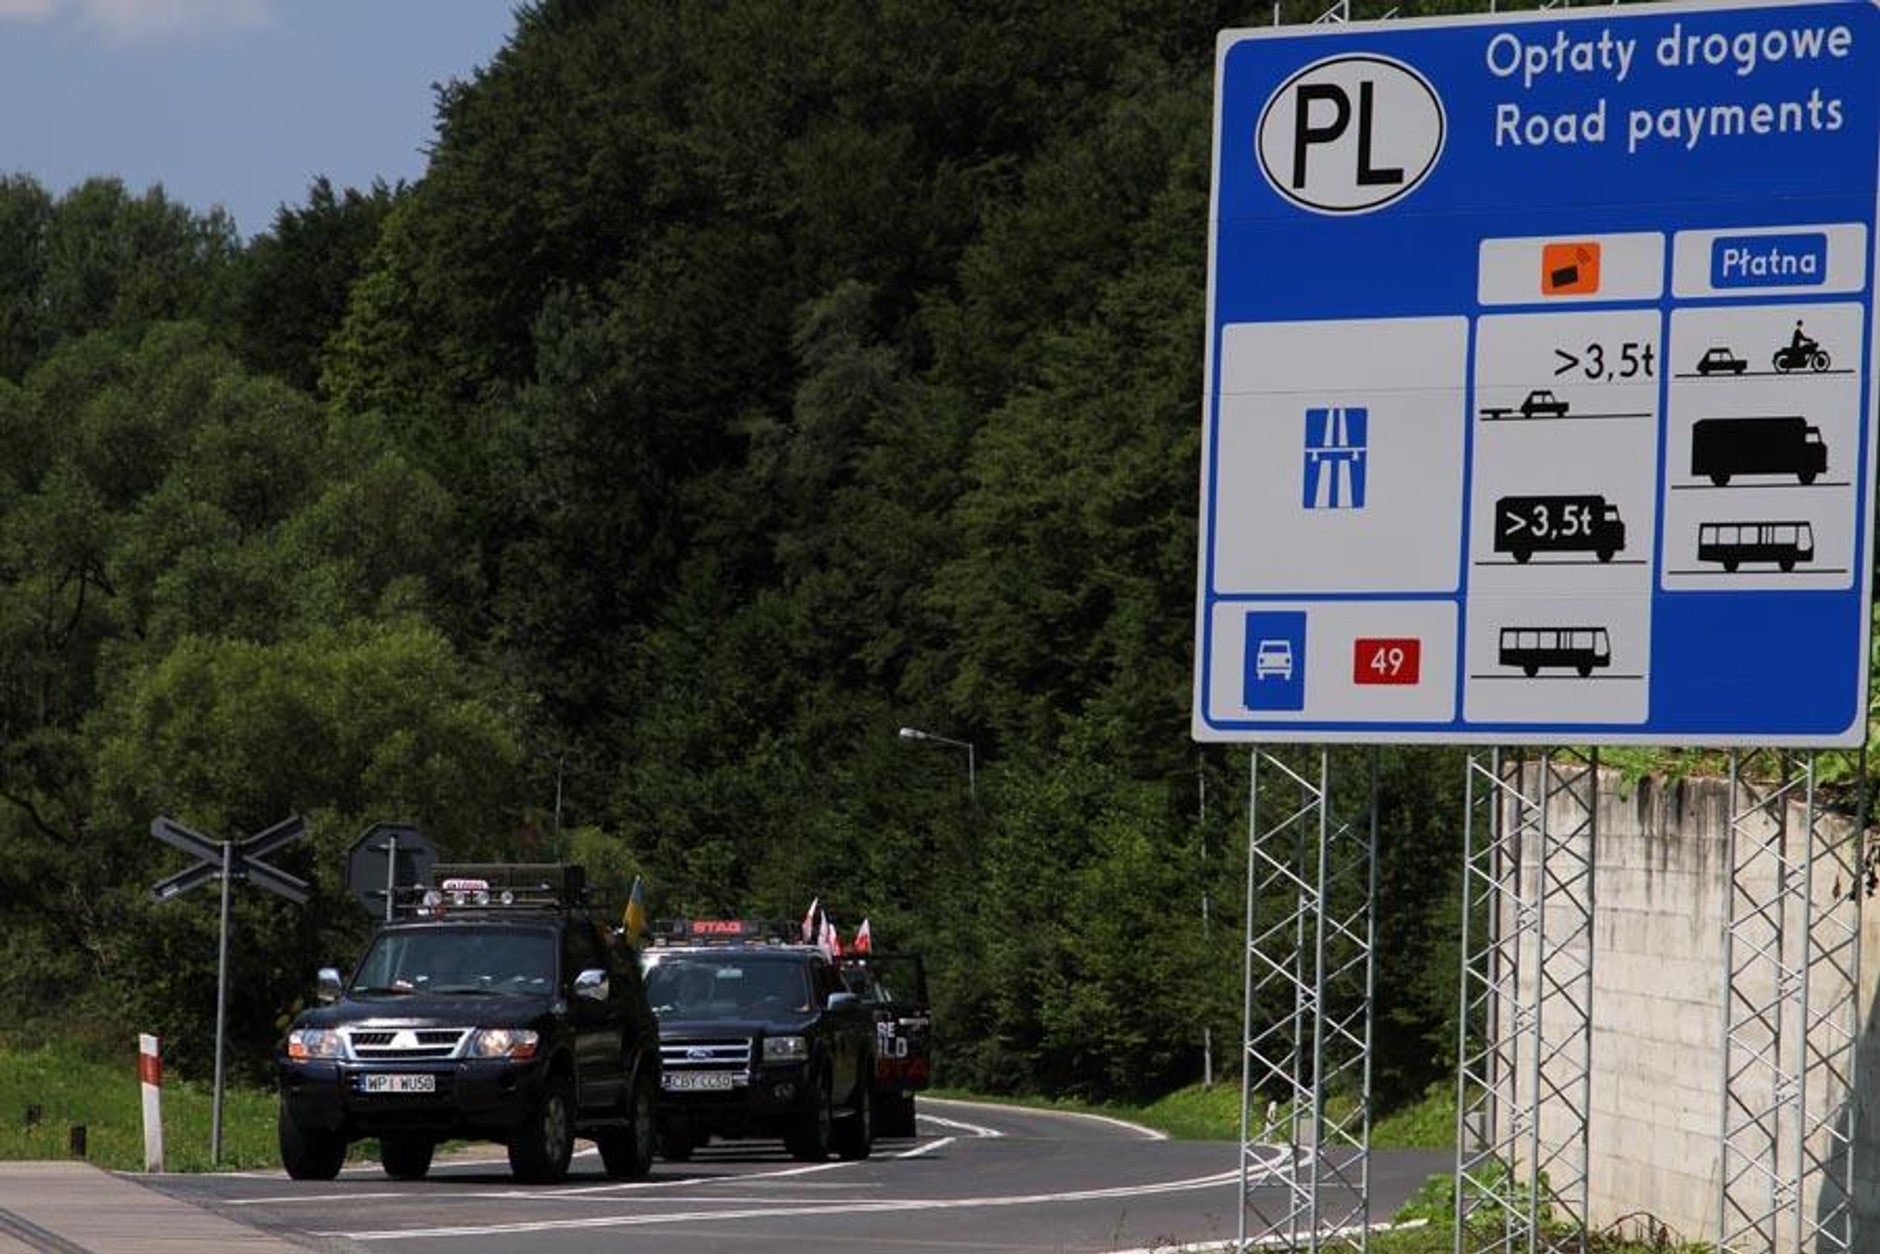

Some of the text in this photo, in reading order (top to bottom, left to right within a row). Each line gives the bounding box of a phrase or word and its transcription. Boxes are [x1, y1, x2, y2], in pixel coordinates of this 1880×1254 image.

[1486, 23, 1853, 89] Opłaty drogowe
[1293, 80, 1405, 189] PL
[1495, 88, 1844, 154] Road payments
[1722, 247, 1817, 278] Płatna
[1370, 647, 1405, 677] 49
